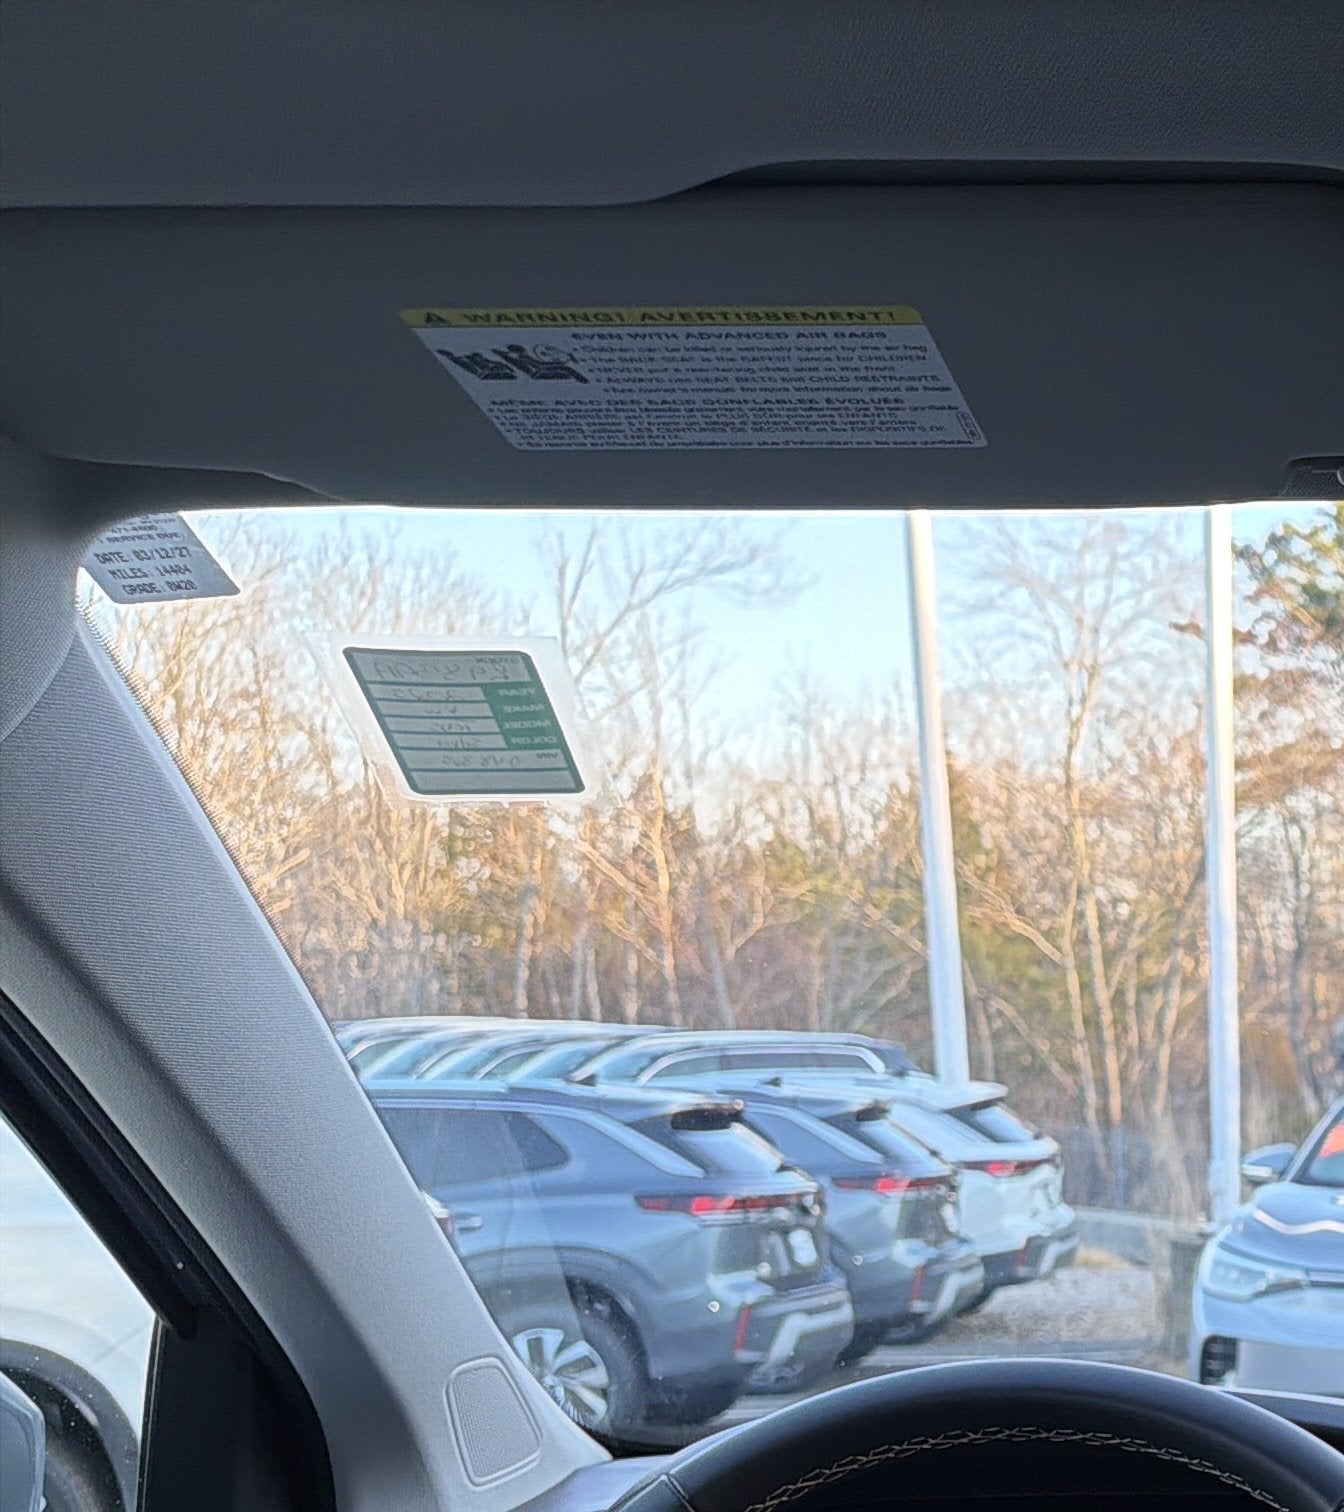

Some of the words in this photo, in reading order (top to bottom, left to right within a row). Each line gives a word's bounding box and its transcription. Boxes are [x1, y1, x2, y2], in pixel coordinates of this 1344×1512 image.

[463, 312, 625, 323] WARNING!
[640, 311, 896, 322] AVERTISSEMENT!
[572, 332, 621, 341] EVEN
[627, 332, 673, 341] WITH
[685, 331, 789, 340] ADVANCED
[797, 331, 827, 340] AIR
[106, 533, 155, 544] SERVICE
